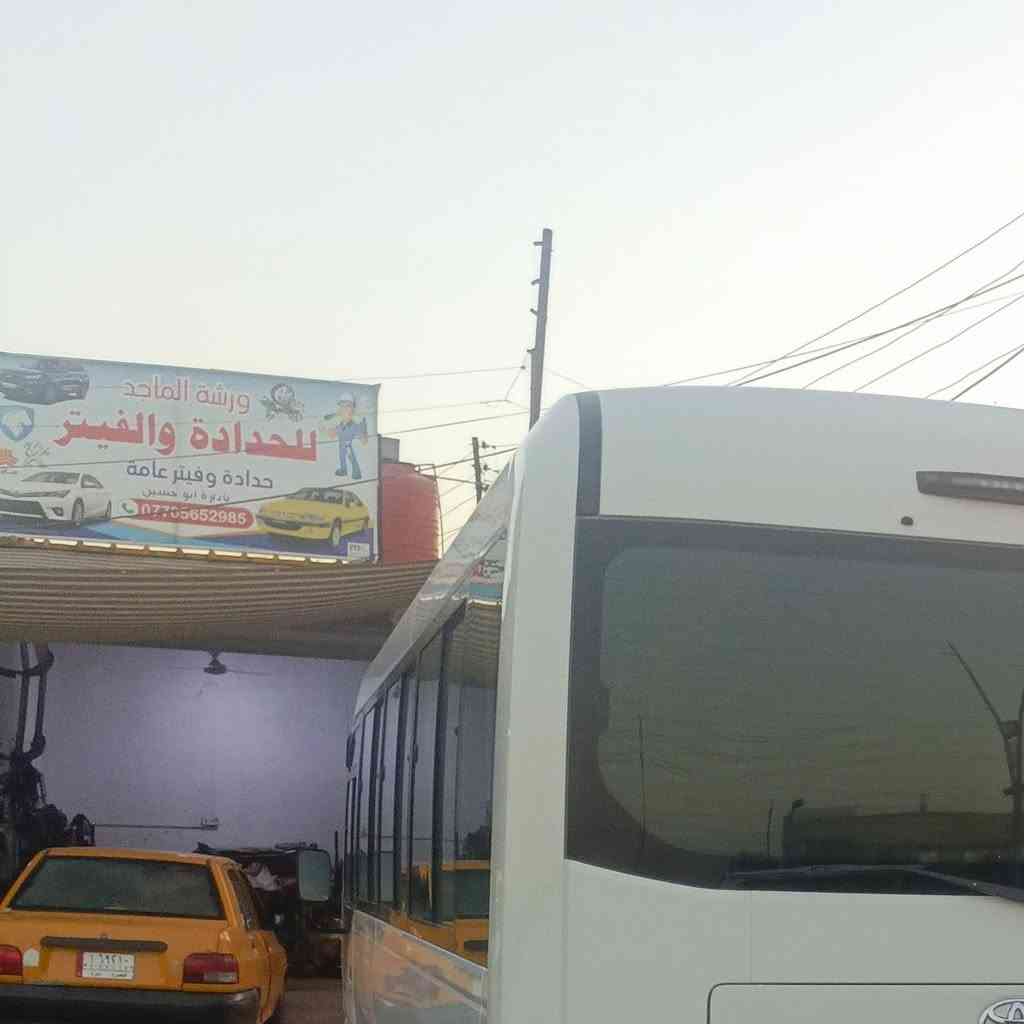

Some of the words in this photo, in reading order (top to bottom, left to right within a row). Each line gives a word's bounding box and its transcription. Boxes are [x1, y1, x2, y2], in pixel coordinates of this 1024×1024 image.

[196, 382, 251, 415] ورشة
[53, 409, 177, 456] والفيتر
[190, 417, 318, 462] للحدادة
[127, 460, 168, 479] عامة
[222, 468, 273, 489] حدادة
